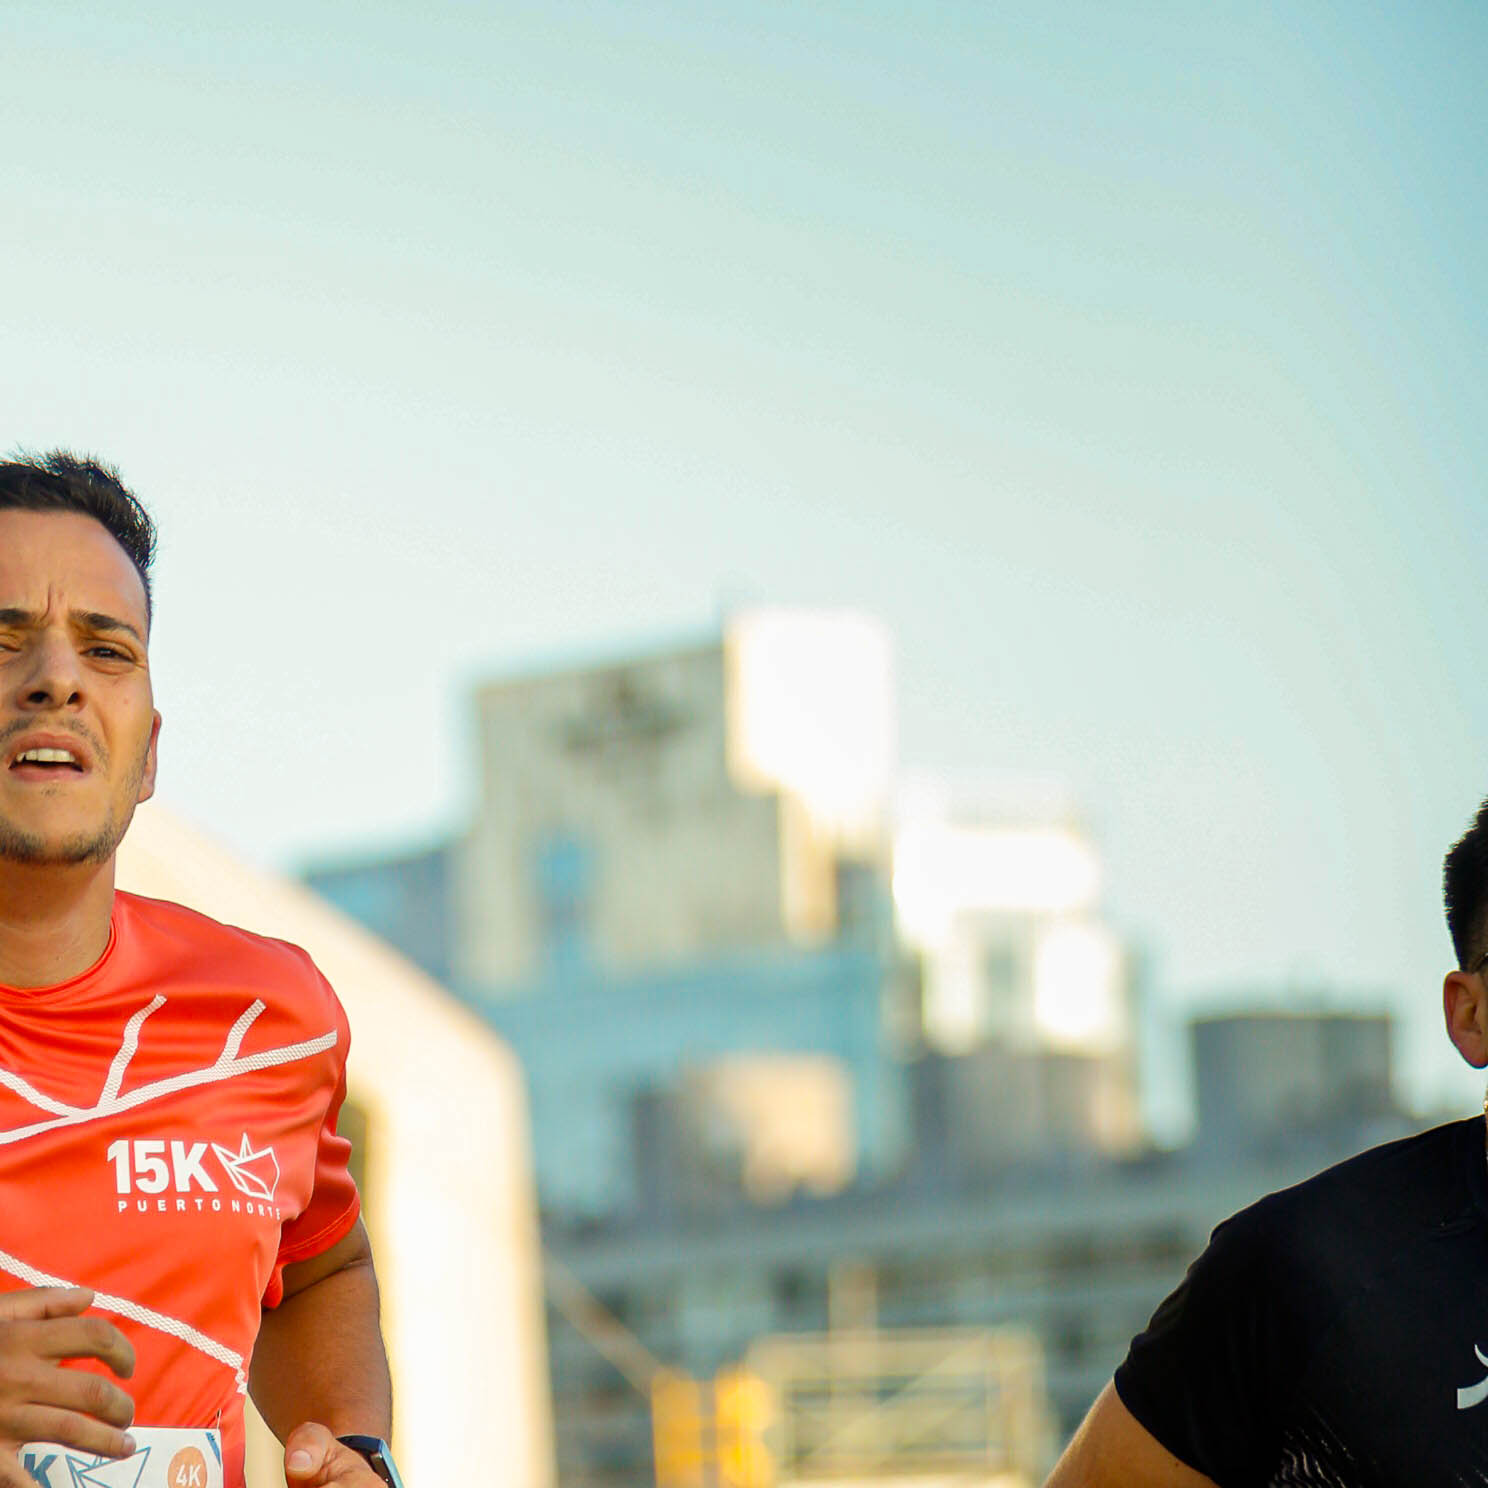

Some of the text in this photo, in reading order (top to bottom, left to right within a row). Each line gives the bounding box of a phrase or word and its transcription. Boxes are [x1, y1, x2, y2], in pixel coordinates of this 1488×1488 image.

[107, 1139, 220, 1194] 15K
[117, 1198, 281, 1221] PUERTO NORTE
[175, 1463, 202, 1488] 4K
